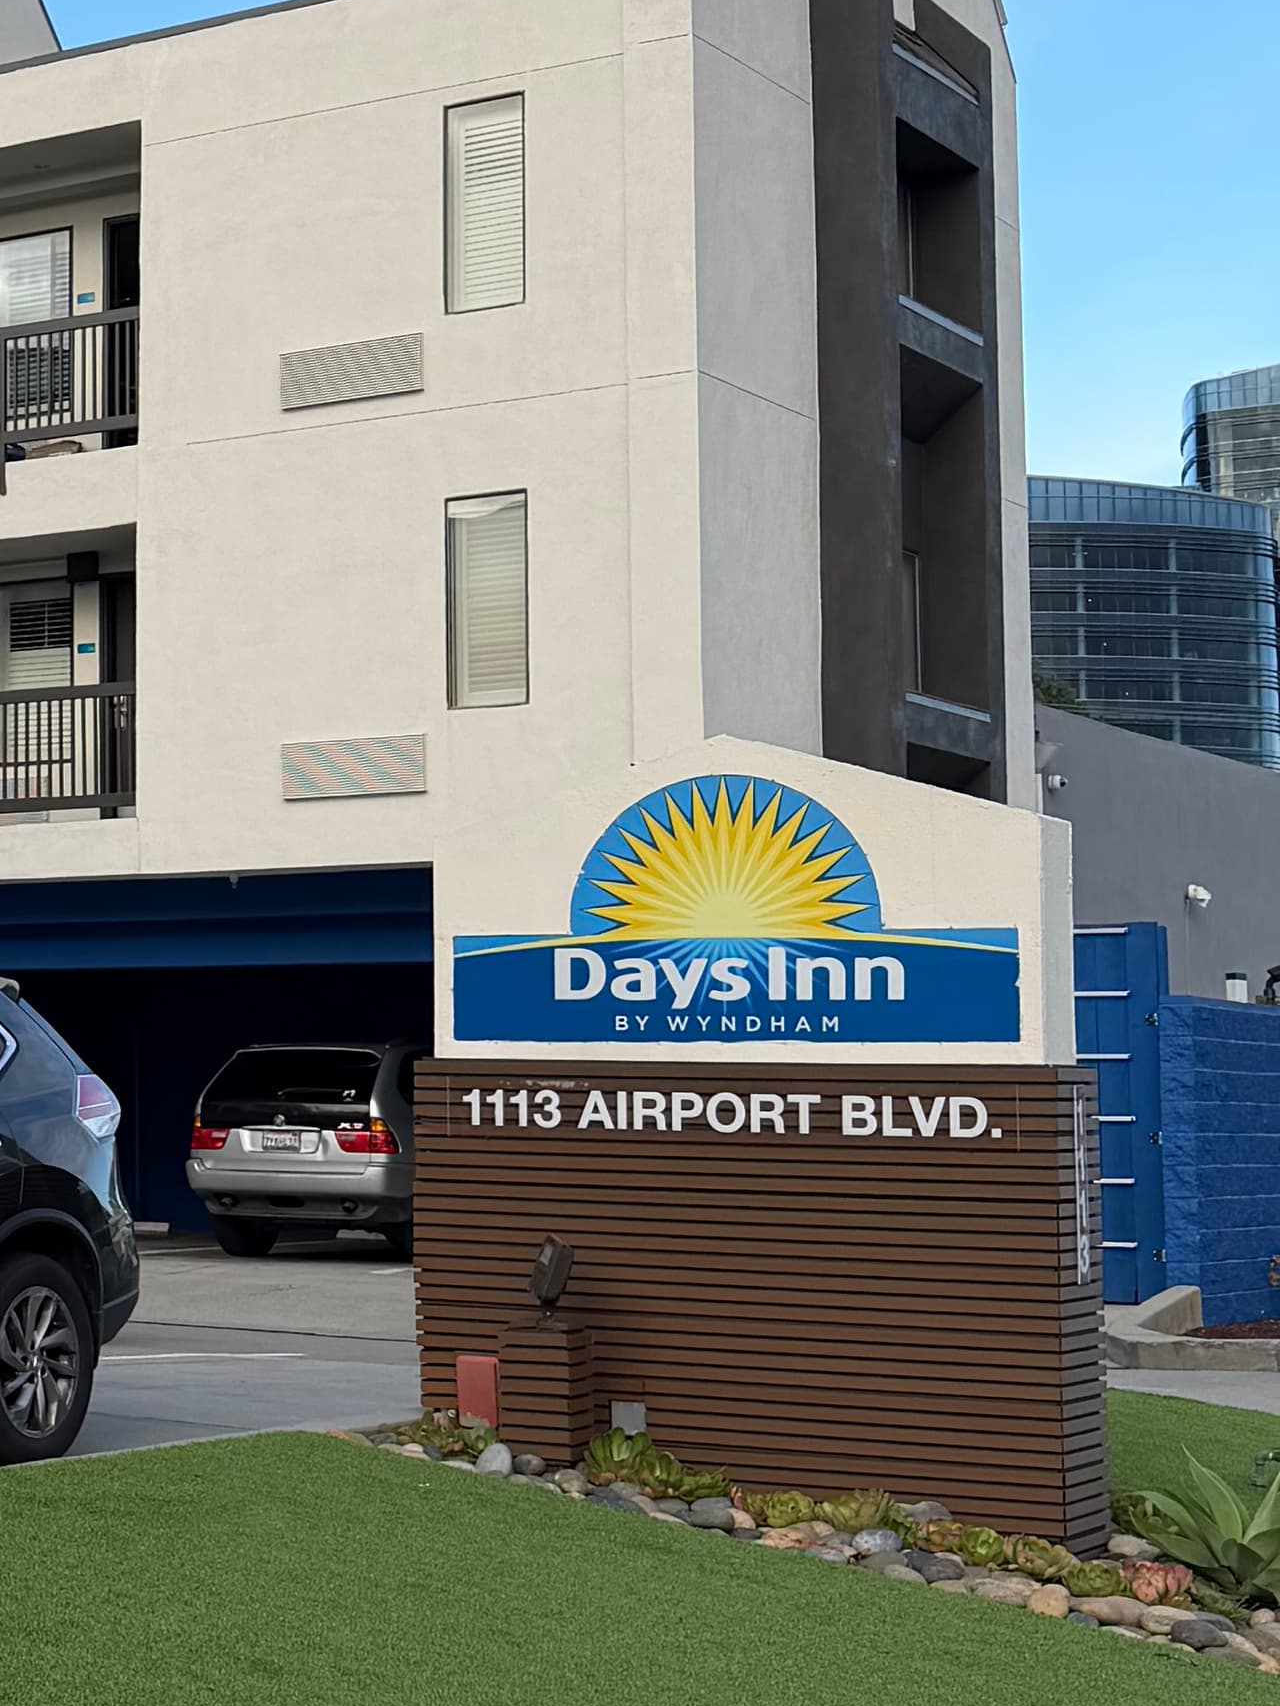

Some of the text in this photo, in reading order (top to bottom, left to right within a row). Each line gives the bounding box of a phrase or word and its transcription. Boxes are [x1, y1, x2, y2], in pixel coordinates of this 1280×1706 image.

[553, 946, 906, 1011] Days Inn
[614, 1015, 840, 1033] BY WYNDHAM
[461, 1088, 1003, 1139] 1113 AIRPORT BLVD.
